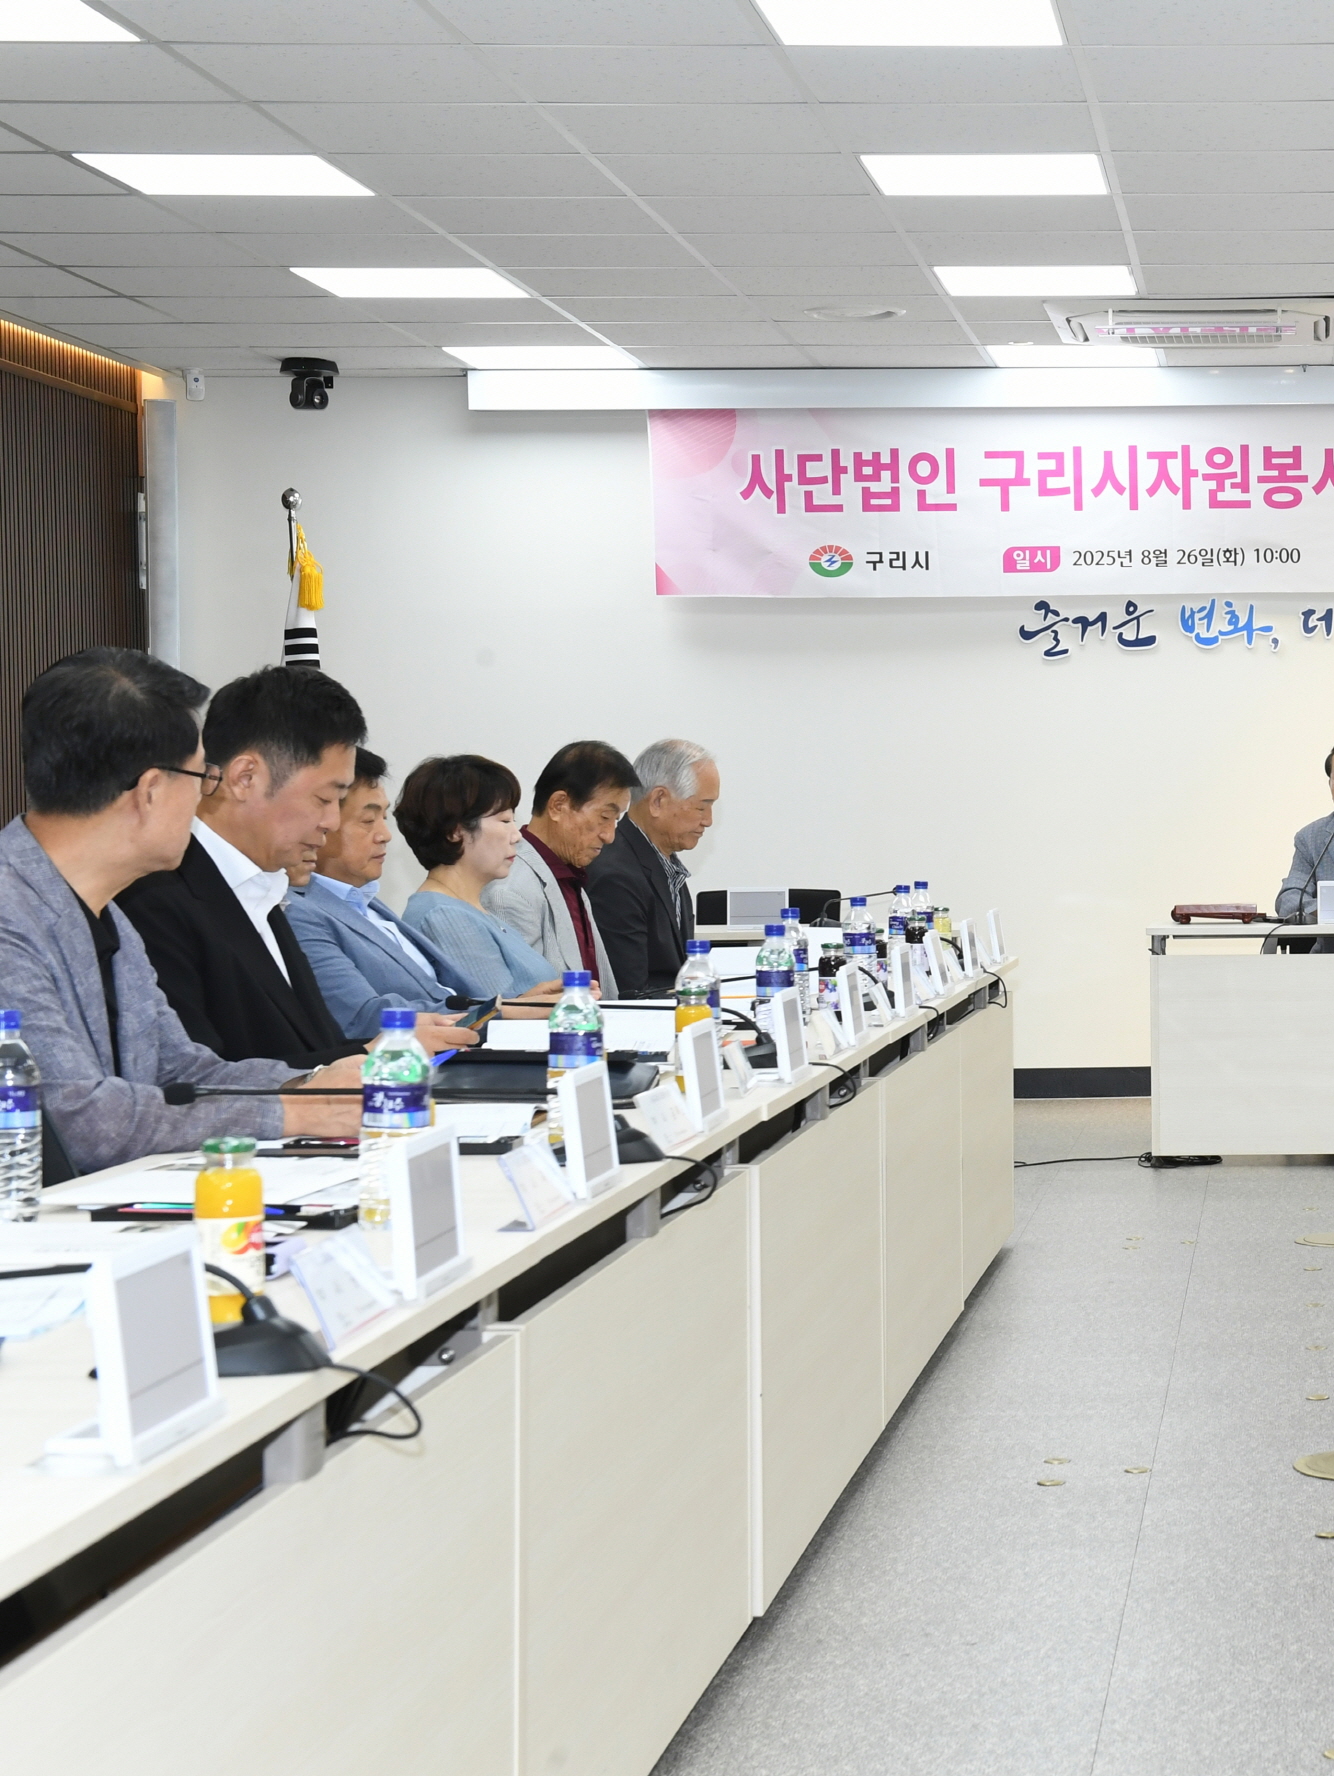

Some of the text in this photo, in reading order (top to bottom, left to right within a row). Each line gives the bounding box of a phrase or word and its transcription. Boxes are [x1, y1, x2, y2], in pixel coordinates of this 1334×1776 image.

[740, 447, 958, 514] 사단법인
[865, 551, 930, 572] 구리시
[1013, 547, 1301, 570] 일시 2025년 8월 26일(화) 10:00
[1019, 600, 1157, 657] 즐거운
[1180, 598, 1280, 651] 변화,
[1301, 607, 1334, 638] 더
